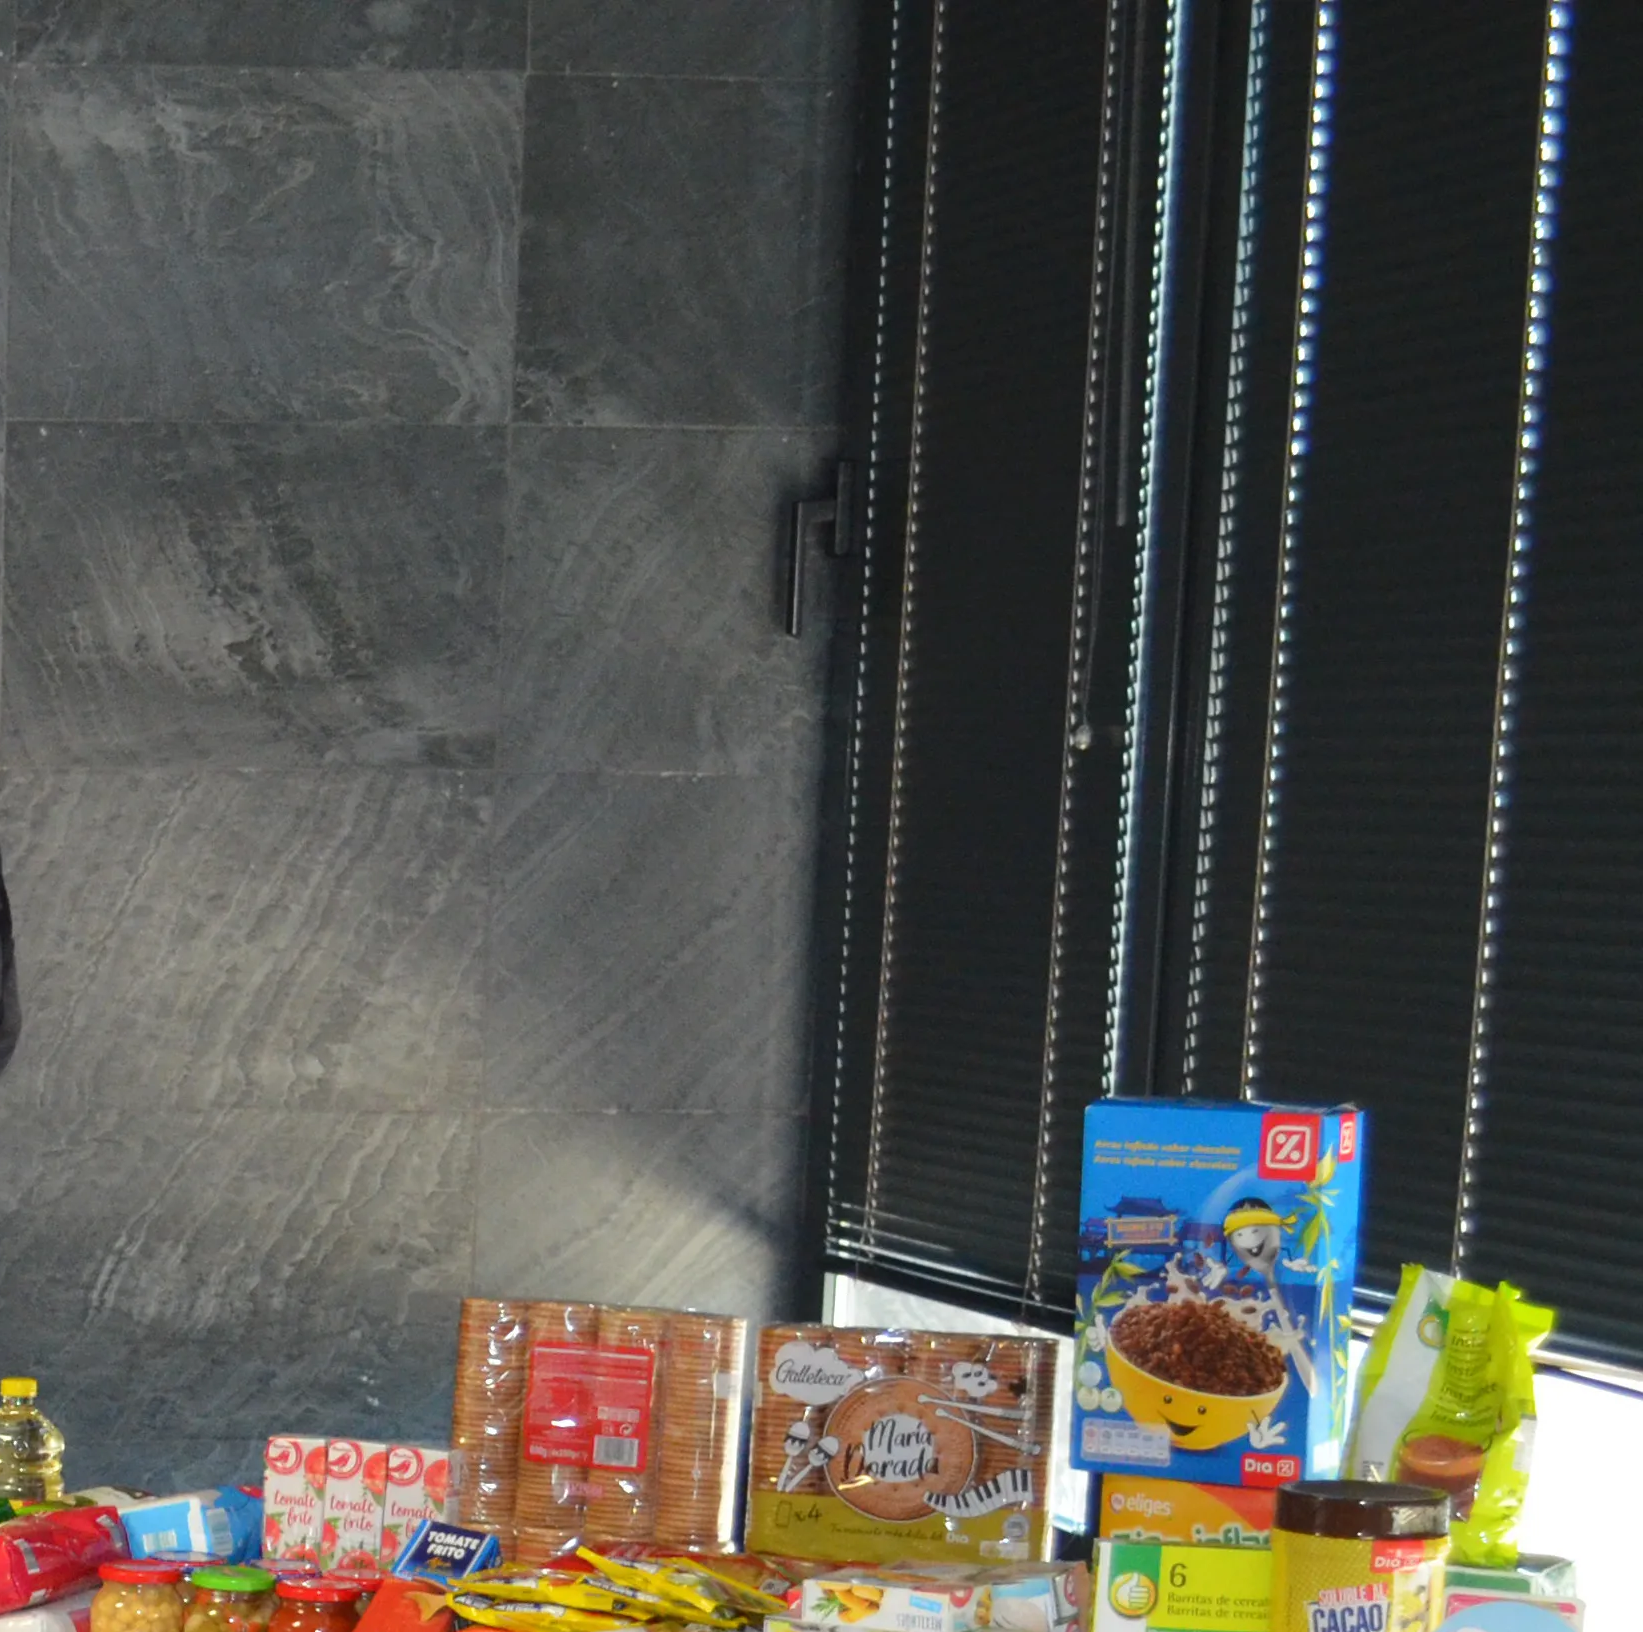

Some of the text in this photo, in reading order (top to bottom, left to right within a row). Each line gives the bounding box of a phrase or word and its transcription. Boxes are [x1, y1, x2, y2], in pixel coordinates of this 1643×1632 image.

[842, 1442, 940, 1484] Dorada
[1244, 1458, 1273, 1474] Dia
[273, 1489, 315, 1509] tomate
[329, 1494, 375, 1515] tomate
[286, 1507, 313, 1528] frito
[343, 1512, 374, 1533] frito
[426, 1542, 466, 1561] FRITO
[427, 1531, 481, 1551] TOMATE
[1374, 1555, 1401, 1569] Dia
[1168, 1562, 1187, 1588] 6
[1318, 1582, 1388, 1605] SOLUBLE AL
